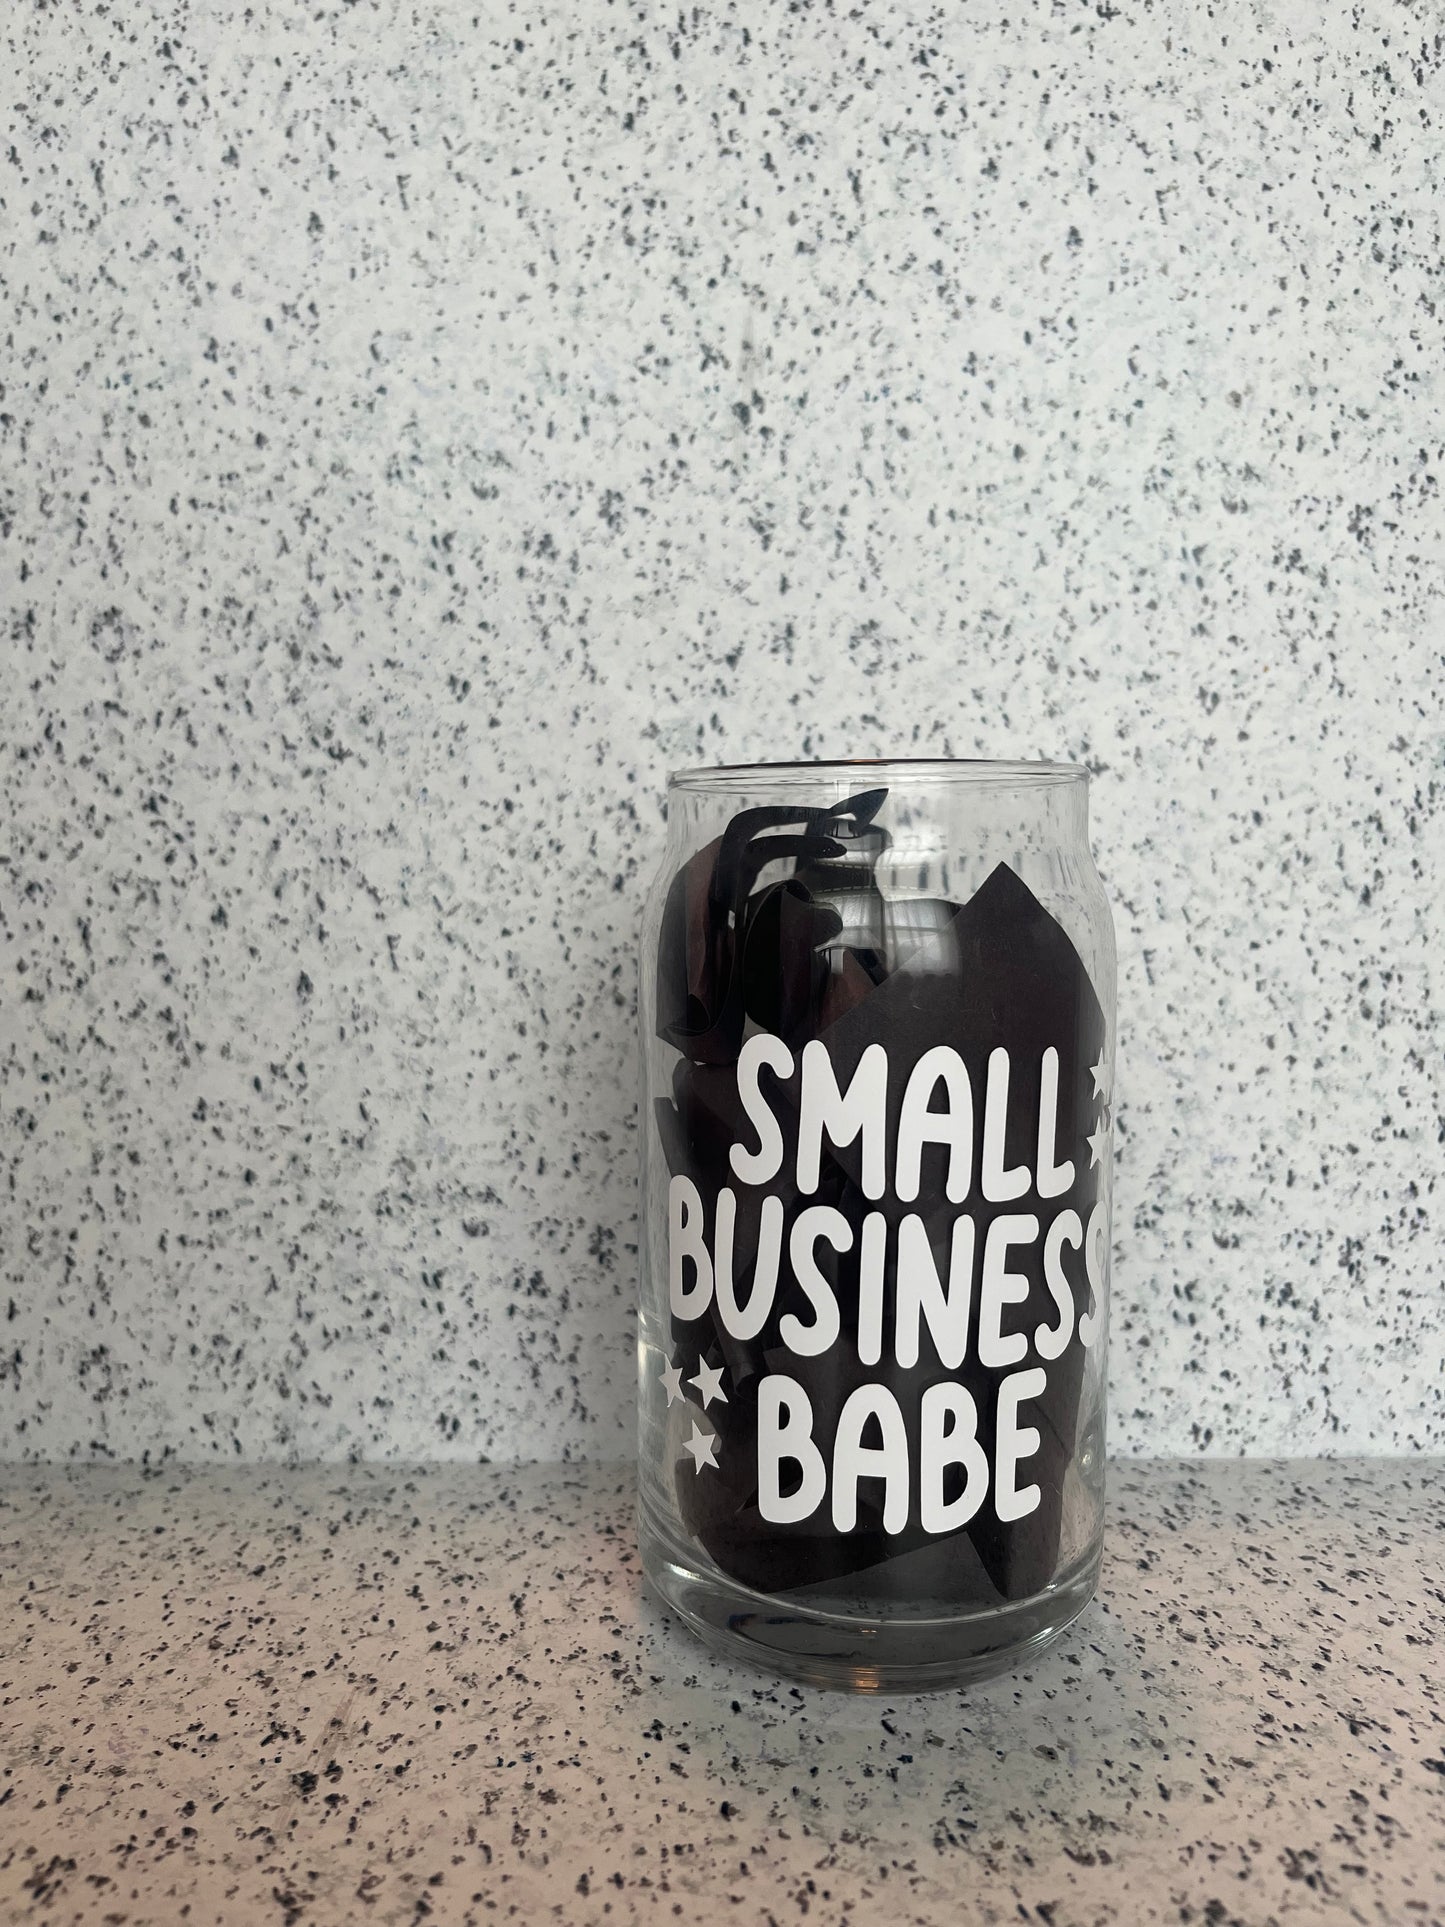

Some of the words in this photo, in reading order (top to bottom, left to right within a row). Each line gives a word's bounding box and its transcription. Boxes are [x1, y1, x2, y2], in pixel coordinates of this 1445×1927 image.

[729, 1033, 1076, 1204] SMALL
[668, 1174, 1108, 1370] BUSINESS
[757, 1367, 1047, 1535] BABE
